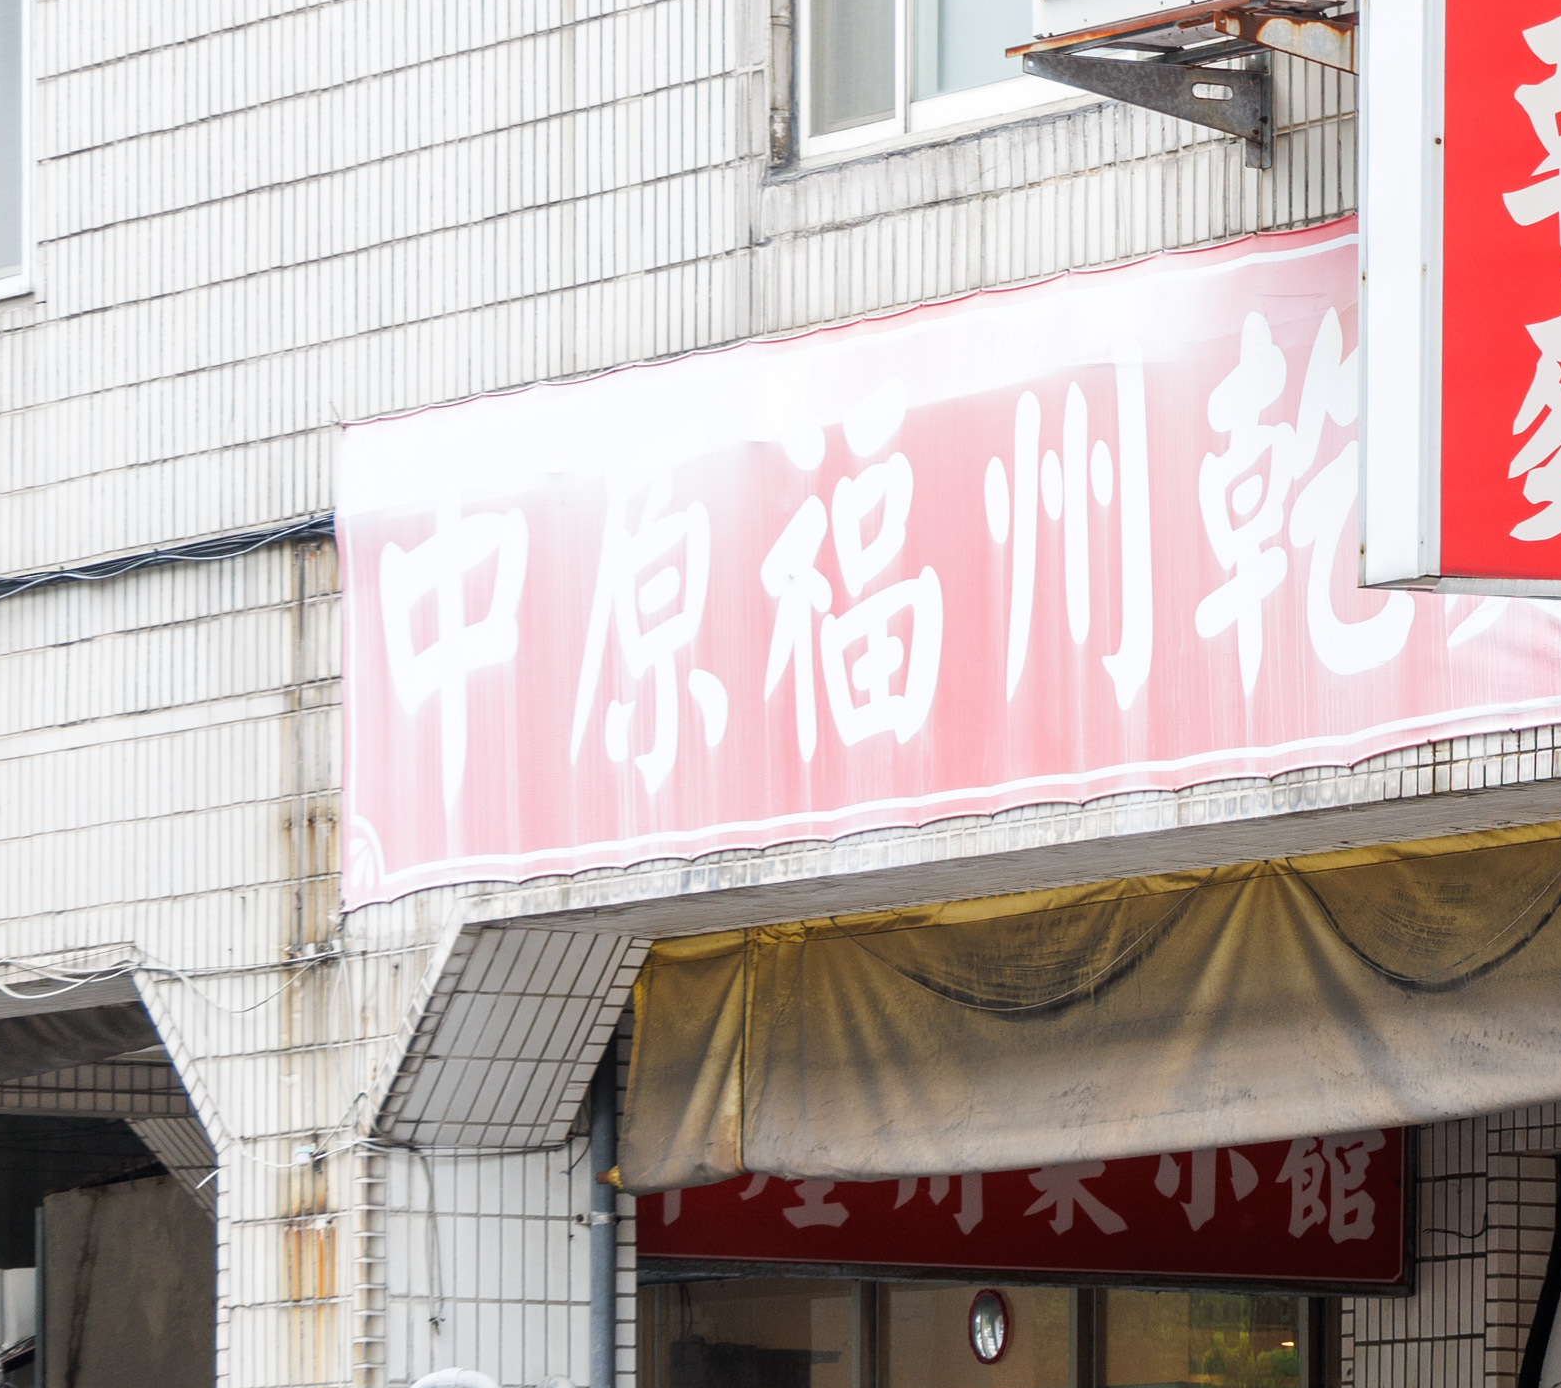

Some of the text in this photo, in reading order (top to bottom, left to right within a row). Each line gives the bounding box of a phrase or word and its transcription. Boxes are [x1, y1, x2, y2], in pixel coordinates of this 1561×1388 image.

[381, 302, 1529, 814] 中原福州乾
